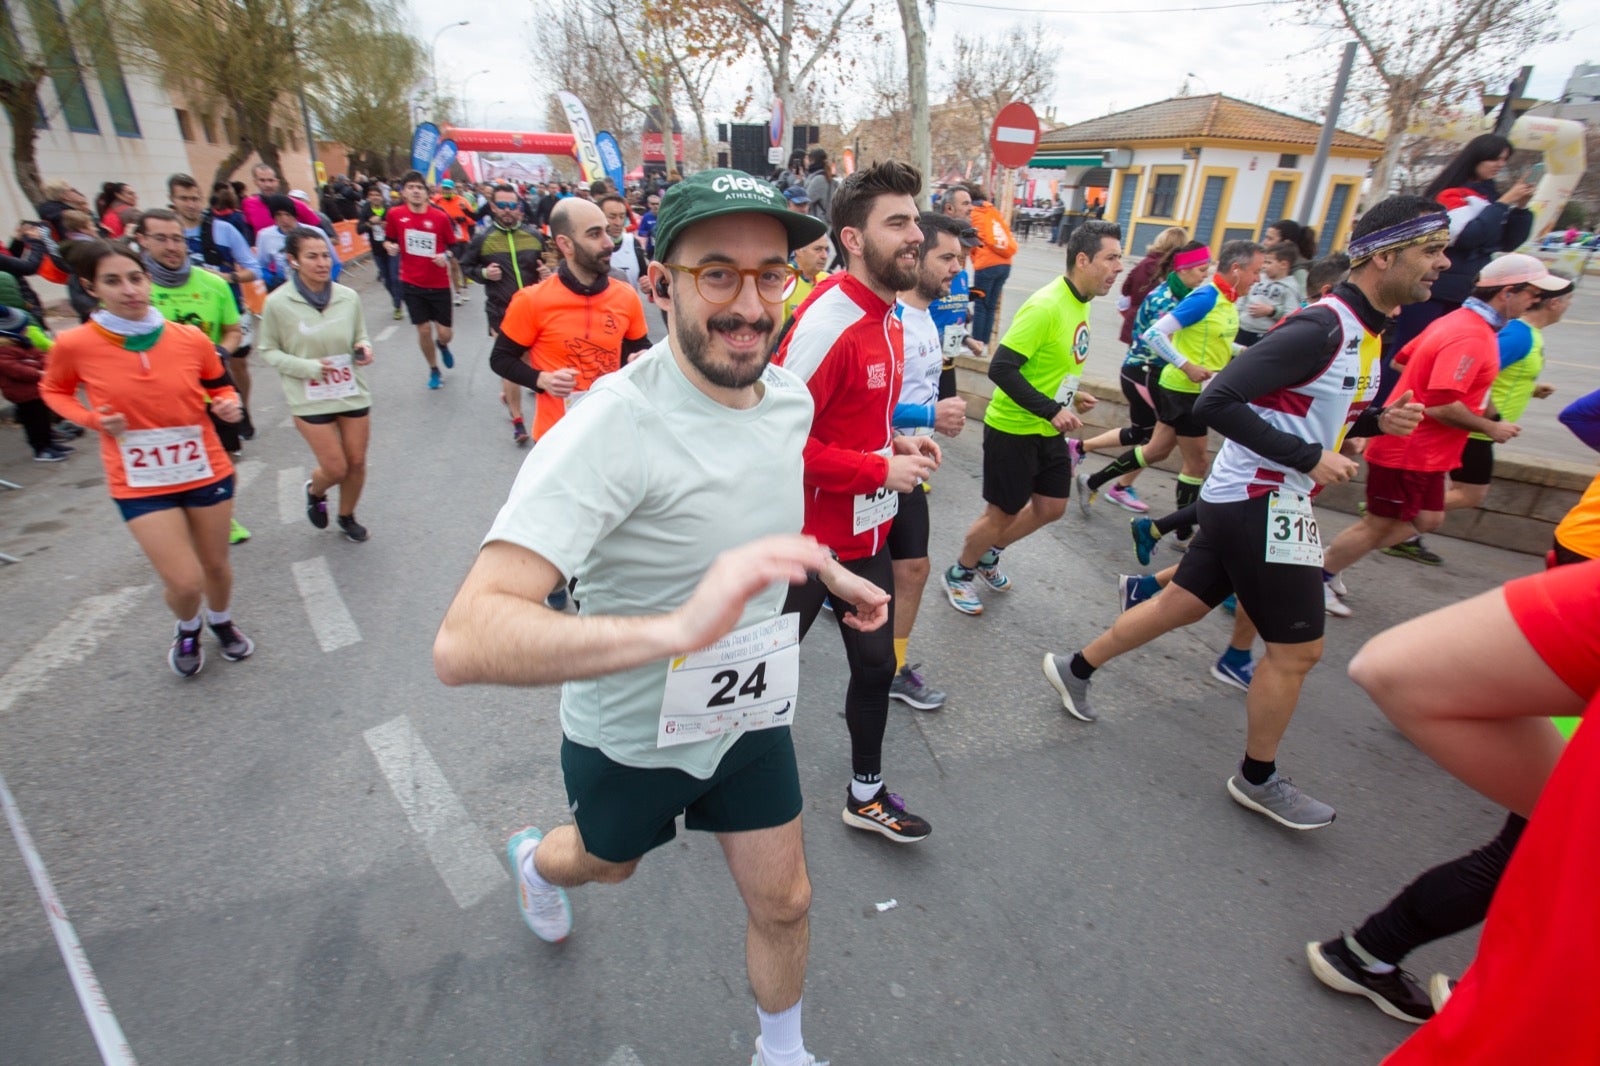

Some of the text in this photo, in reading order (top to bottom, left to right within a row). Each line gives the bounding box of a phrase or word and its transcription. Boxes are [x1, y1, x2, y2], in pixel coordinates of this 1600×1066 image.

[725, 192, 772, 205] ATHLETICS
[408, 237, 433, 250] 3152
[128, 440, 202, 468] 2172
[706, 661, 767, 708] 24
